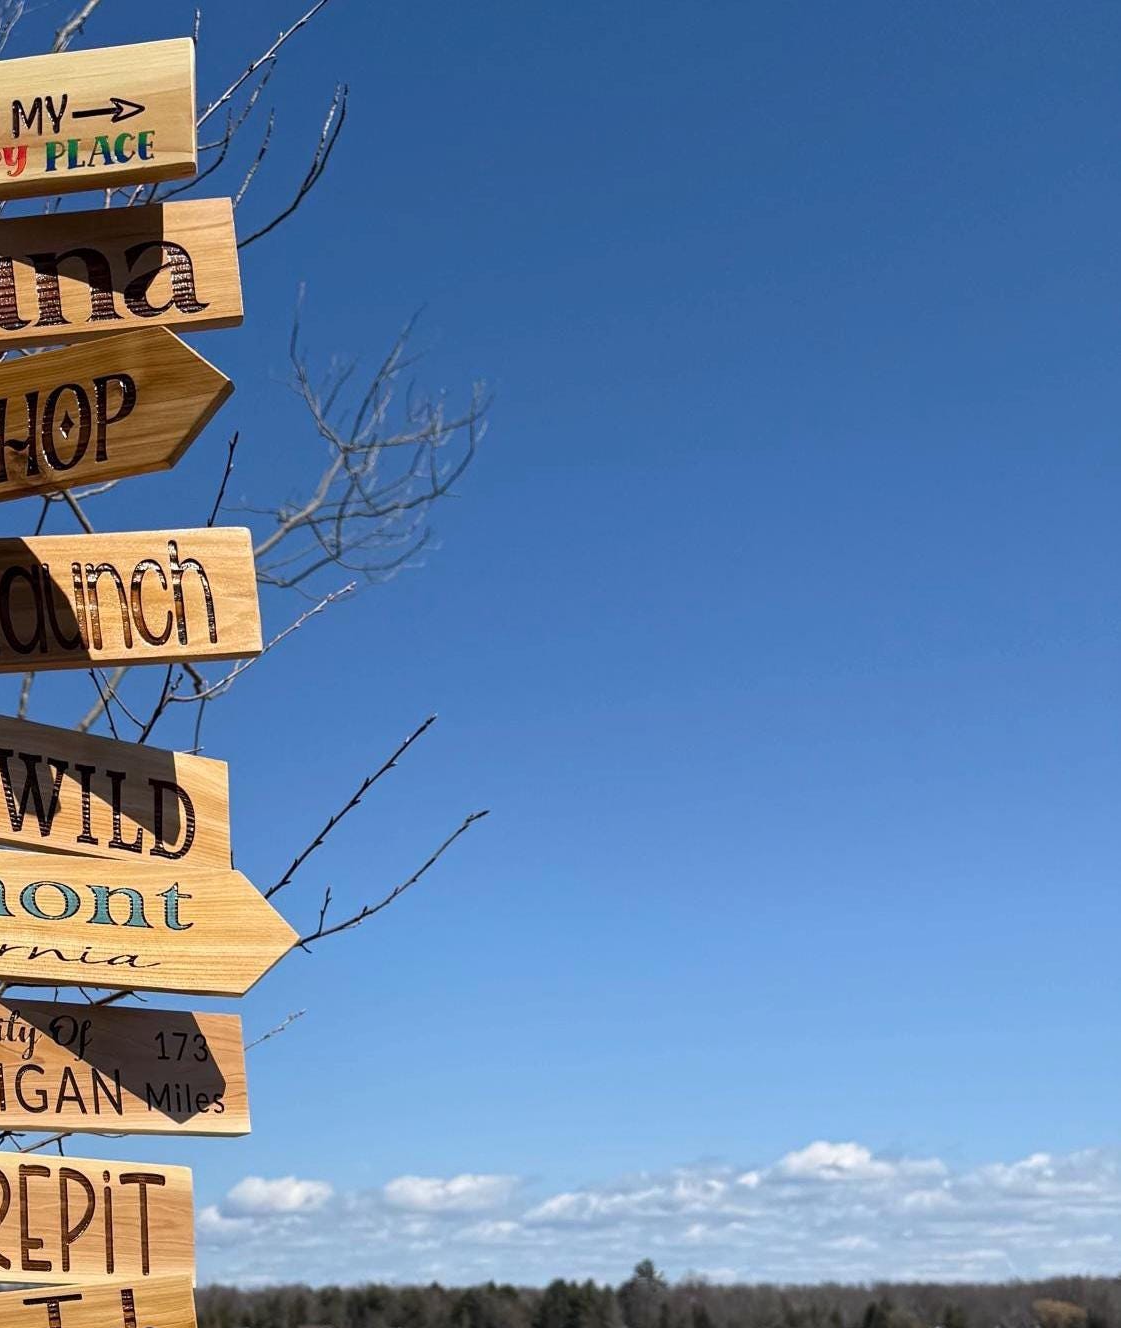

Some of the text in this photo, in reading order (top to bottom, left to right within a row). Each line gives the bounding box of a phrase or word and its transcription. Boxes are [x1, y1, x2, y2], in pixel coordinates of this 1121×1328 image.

[12, 93, 68, 139] MY
[44, 128, 157, 173] PLACE
[48, 1014, 93, 1062] Of
[154, 1031, 208, 1062] 173
[145, 1082, 226, 1114] Miles
